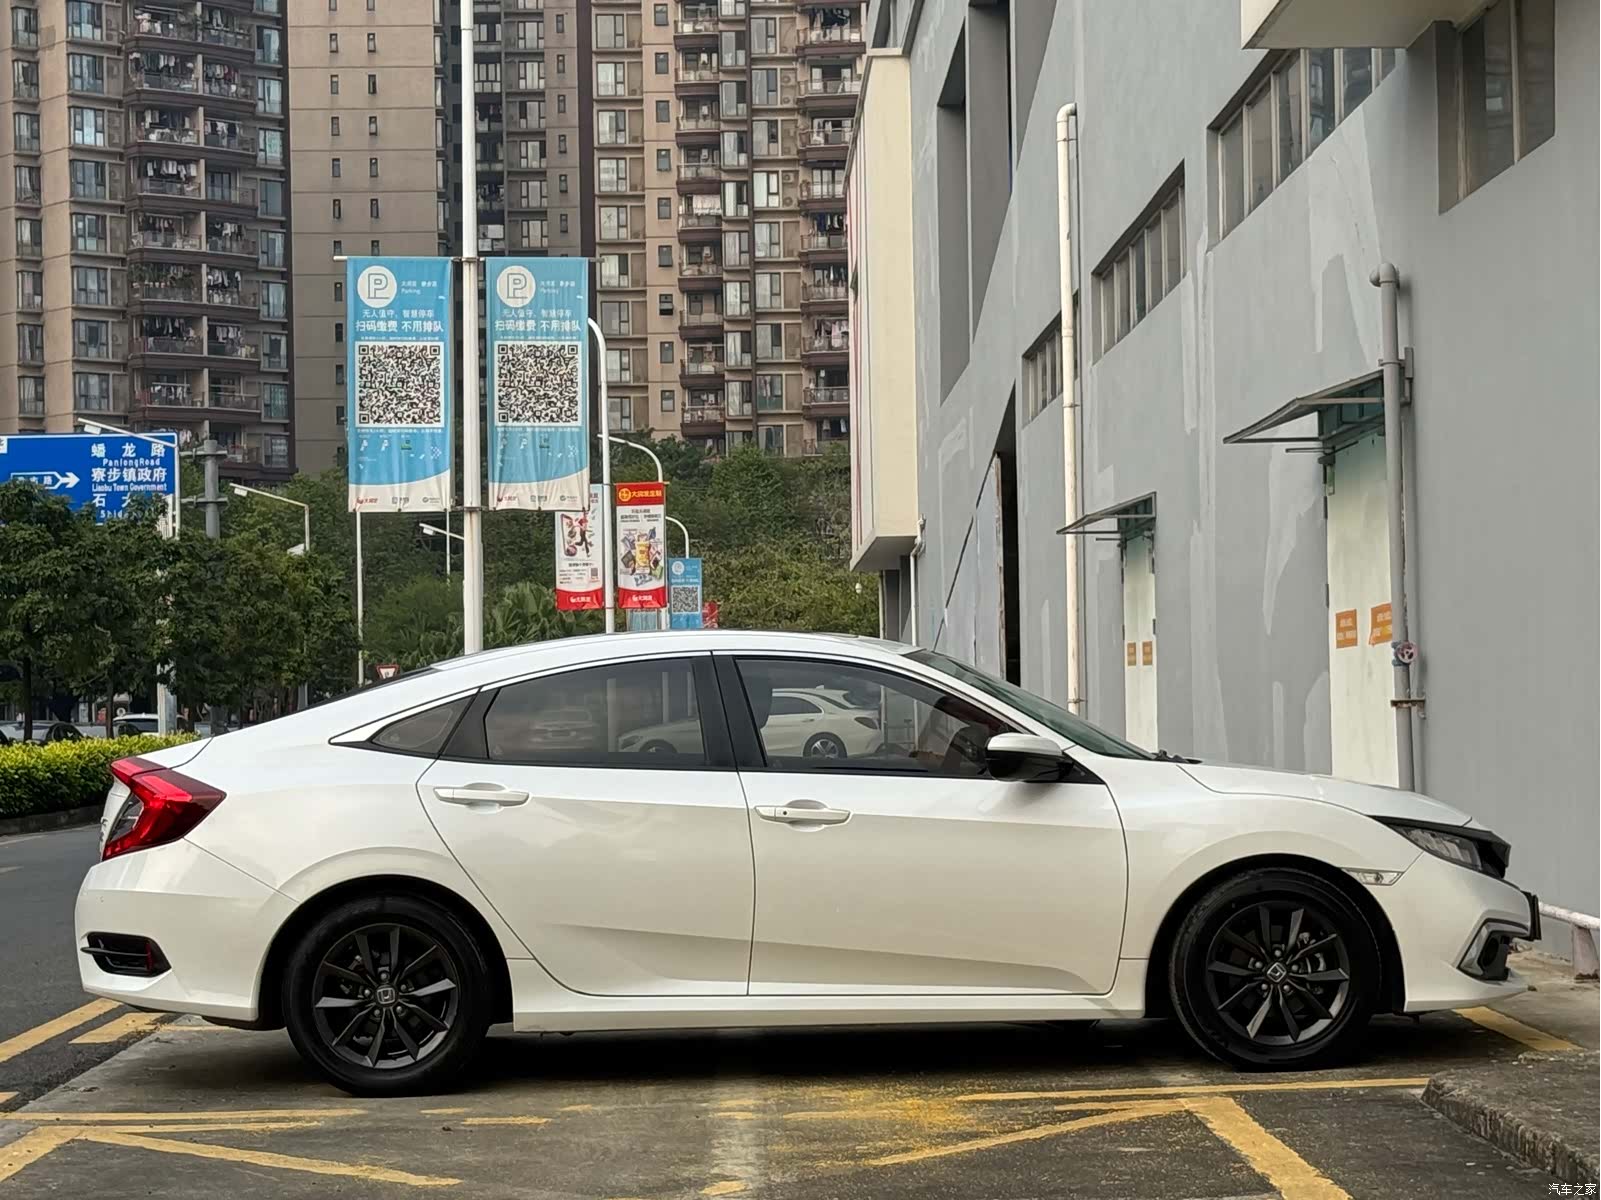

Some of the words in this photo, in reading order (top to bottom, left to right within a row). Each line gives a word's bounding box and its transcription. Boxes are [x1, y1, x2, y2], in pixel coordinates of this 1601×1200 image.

[356, 320, 398, 332] 扫码缴费
[401, 320, 444, 332] 不用排队
[495, 319, 537, 332] 扫码缴费
[540, 319, 582, 332] 不用排队
[91, 442, 166, 458] 蟠龙路
[91, 467, 167, 482] 寮步镇政府
[92, 483, 112, 492] Liaobu
[113, 483, 129, 492] Town
[129, 482, 167, 492] Government
